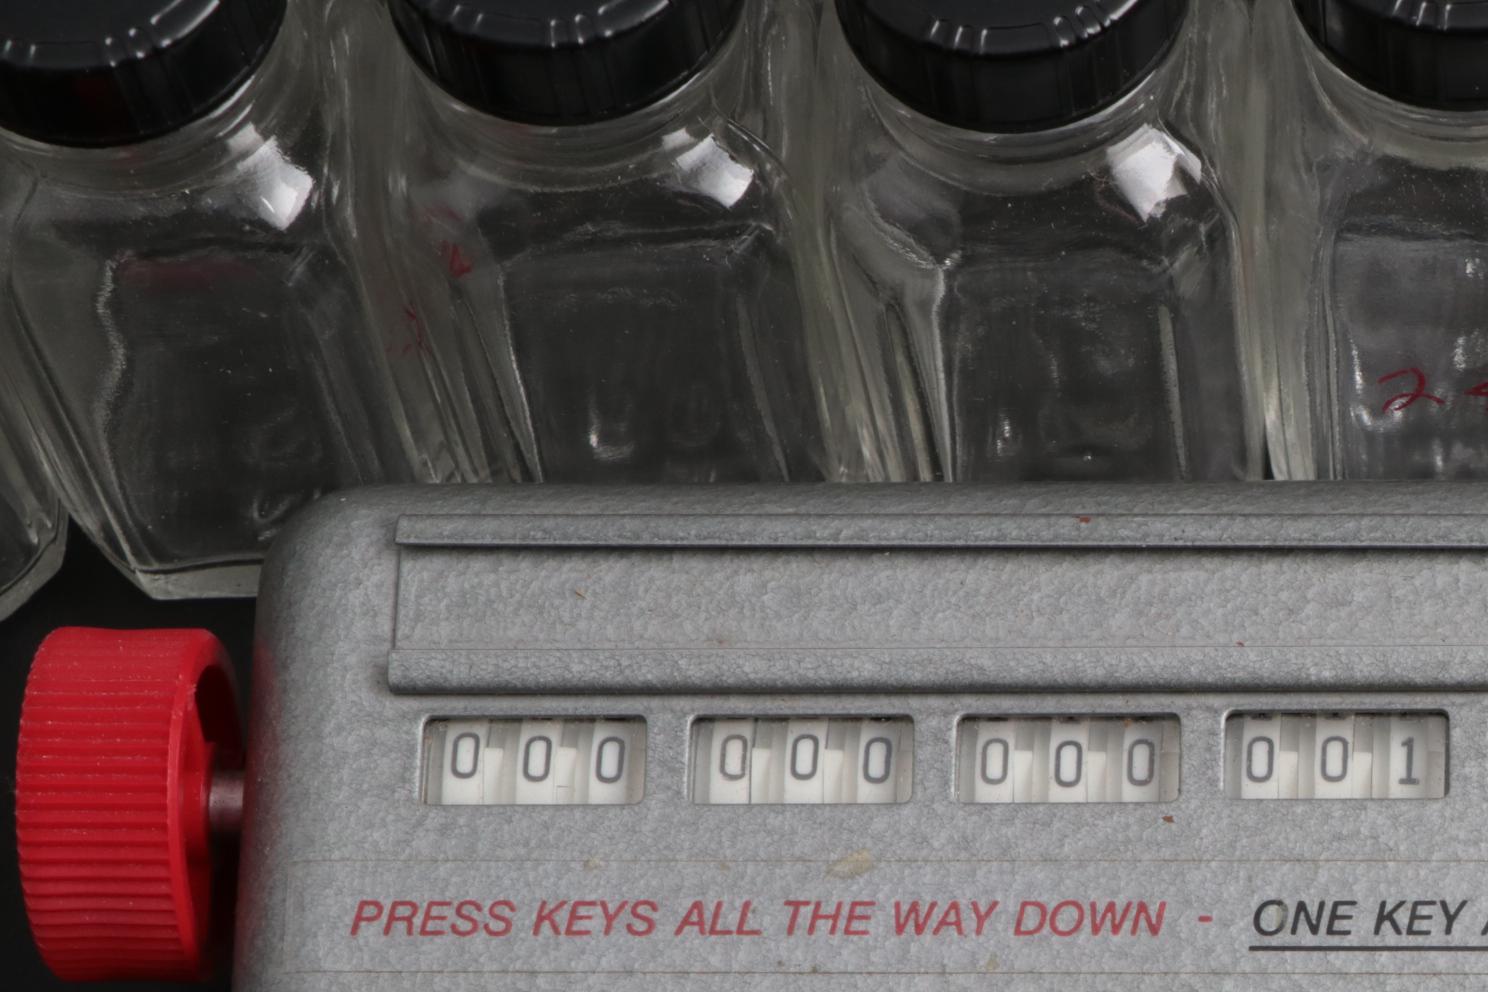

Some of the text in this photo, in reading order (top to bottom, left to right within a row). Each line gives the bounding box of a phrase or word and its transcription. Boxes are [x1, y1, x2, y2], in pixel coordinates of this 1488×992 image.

[350, 899, 517, 937] PRESS
[532, 899, 659, 937] KEYS
[675, 899, 762, 937] ALL
[783, 900, 879, 937] THE
[894, 900, 1000, 937] WAY
[1013, 899, 1168, 938] DOWN
[1253, 899, 1357, 937] ONE
[1373, 900, 1468, 936] KEY
